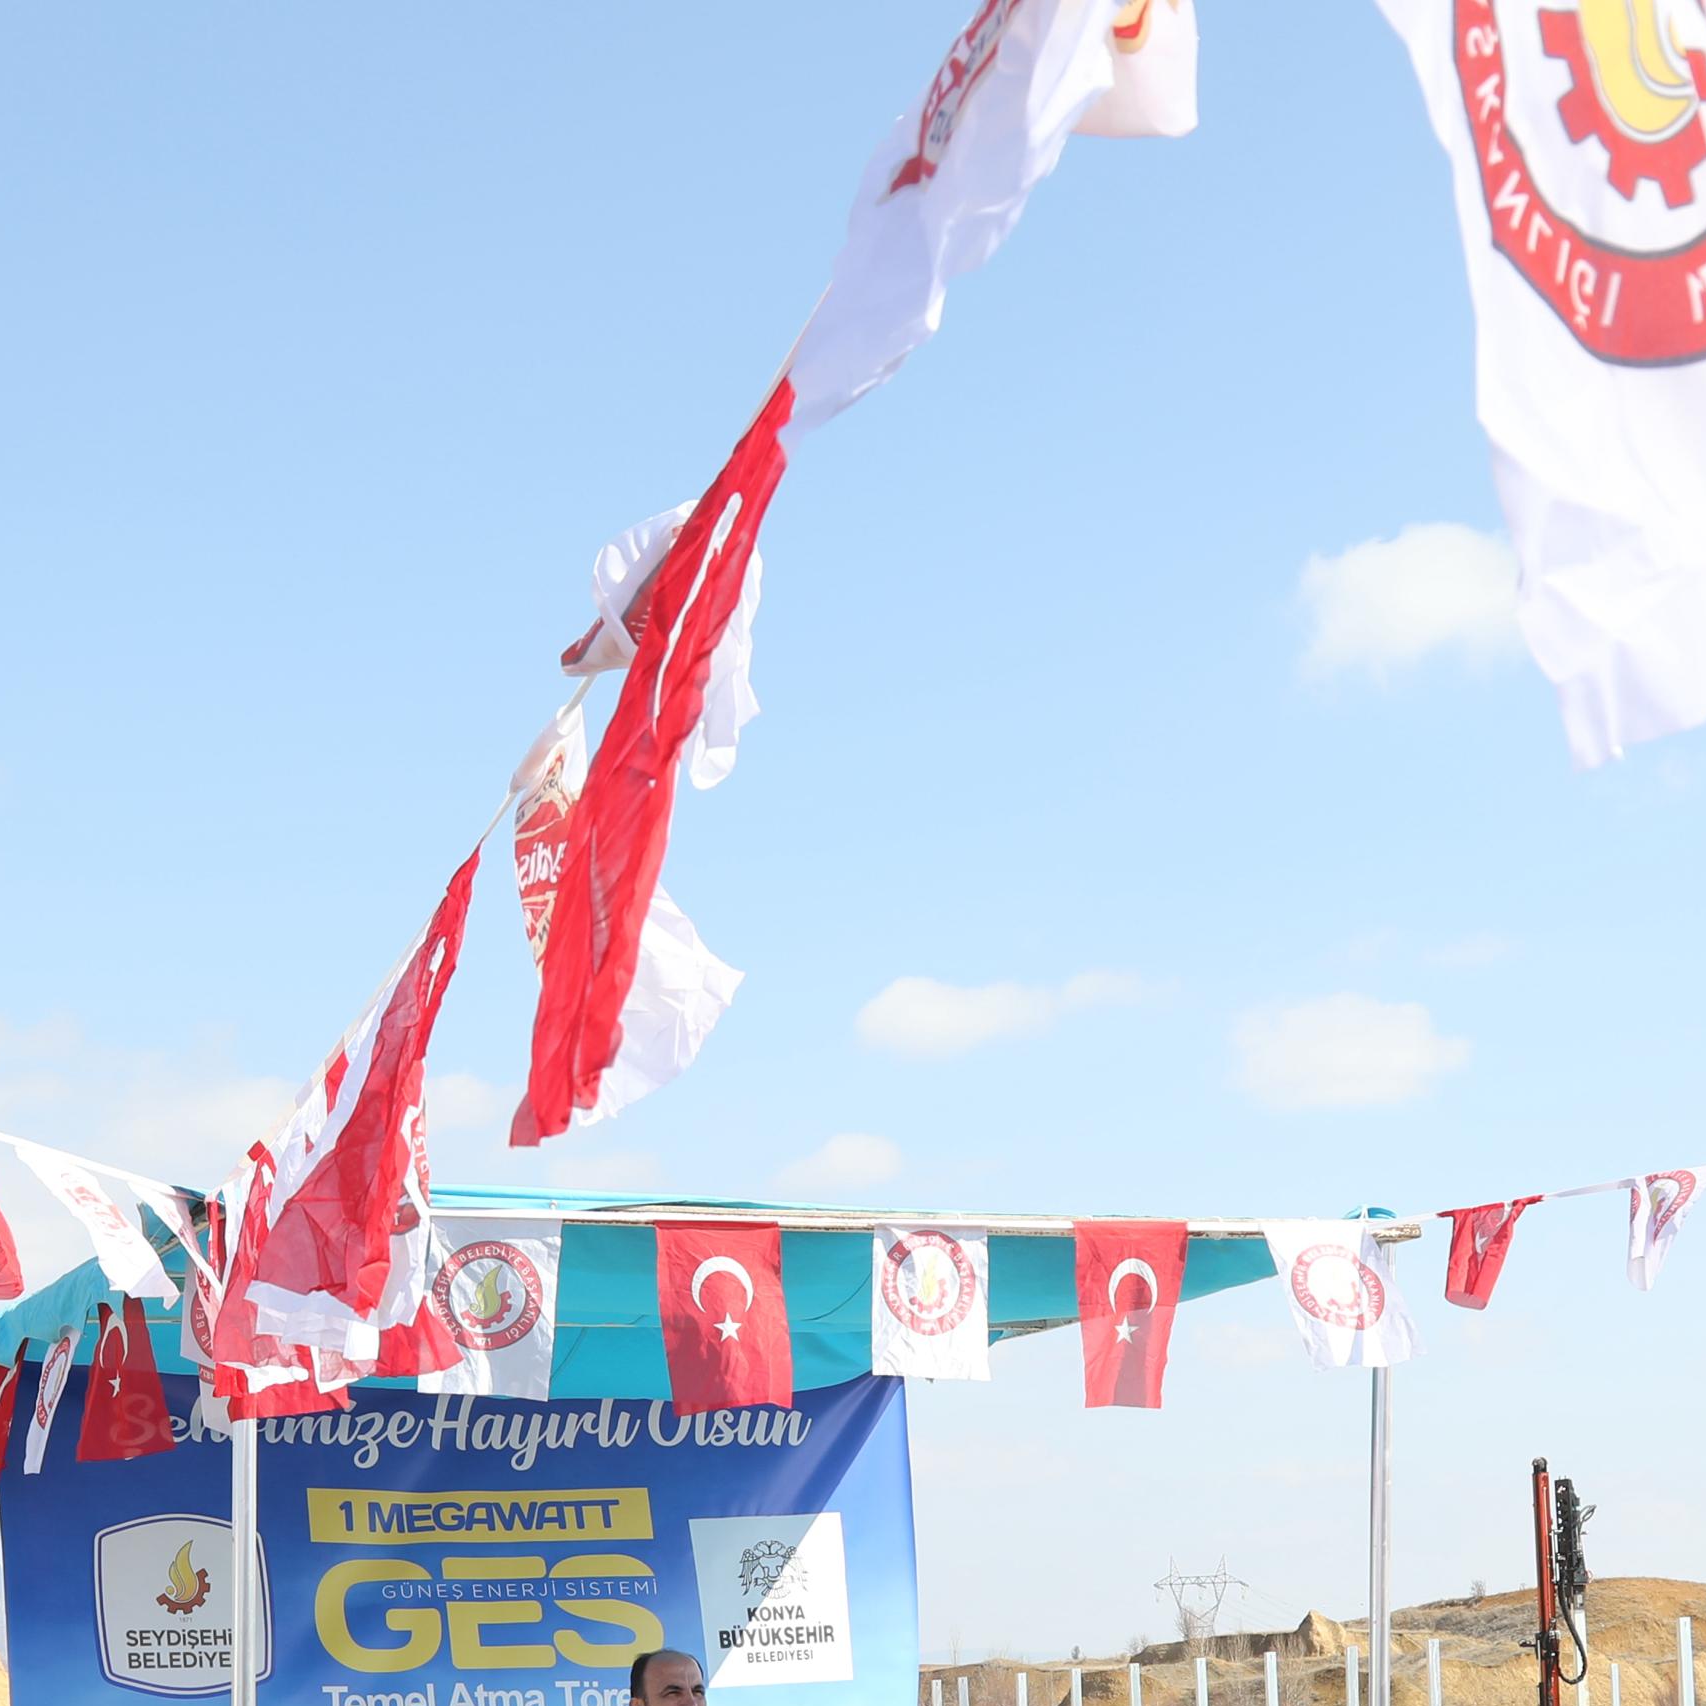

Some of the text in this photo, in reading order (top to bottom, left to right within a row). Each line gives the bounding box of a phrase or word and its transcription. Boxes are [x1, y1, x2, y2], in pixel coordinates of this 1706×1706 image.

[338, 1498, 620, 1534] 1 MEGAWATT
[381, 1578, 659, 1600] GÜNEŞ ENERJİ SİSTEMİ
[314, 1553, 665, 1673] GES
[747, 1605, 805, 1622] KONYA
[125, 1628, 232, 1649] SEYDİŞEHİ
[719, 1621, 835, 1649] BÜYÜKŞEHİR
[127, 1651, 232, 1669] BELEDİYE
